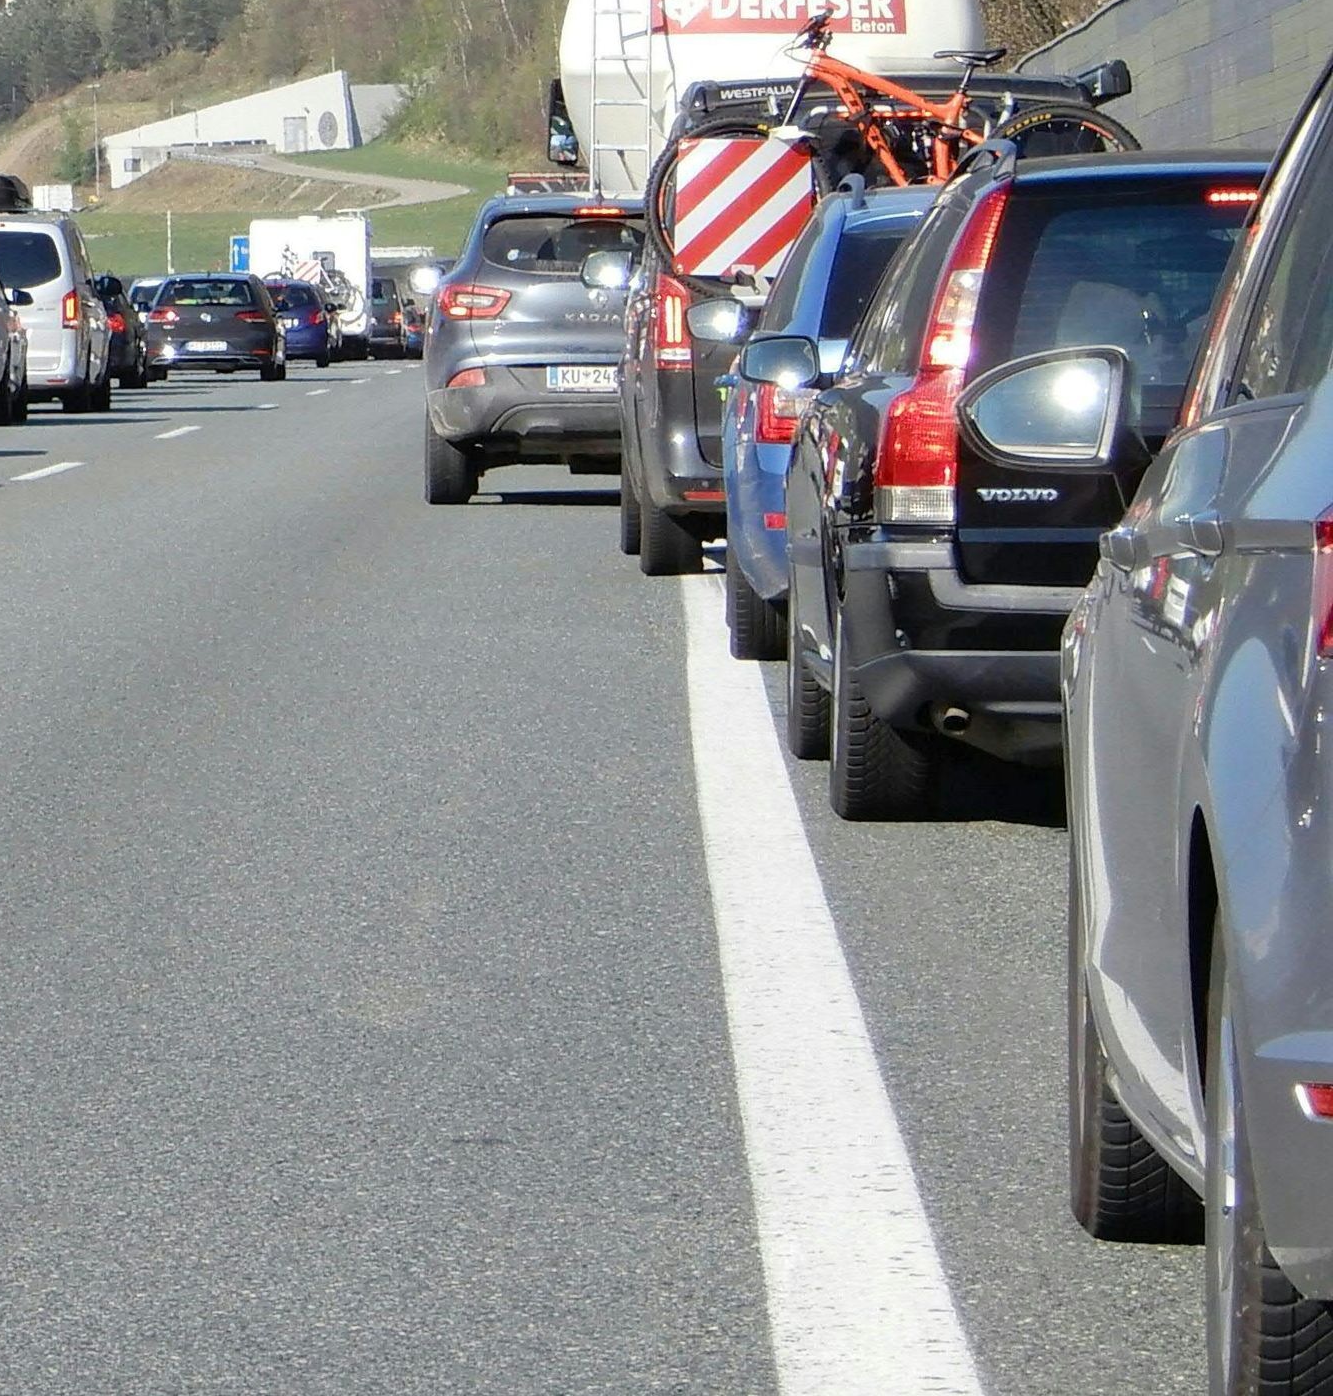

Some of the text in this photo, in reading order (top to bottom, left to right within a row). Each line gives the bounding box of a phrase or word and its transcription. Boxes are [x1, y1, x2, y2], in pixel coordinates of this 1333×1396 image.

[851, 18, 896, 33] Beton
[720, 85, 795, 100] WESTFALIA
[564, 312, 622, 324] KADJA
[561, 369, 581, 384] KU
[976, 488, 1059, 502] VOLVO
